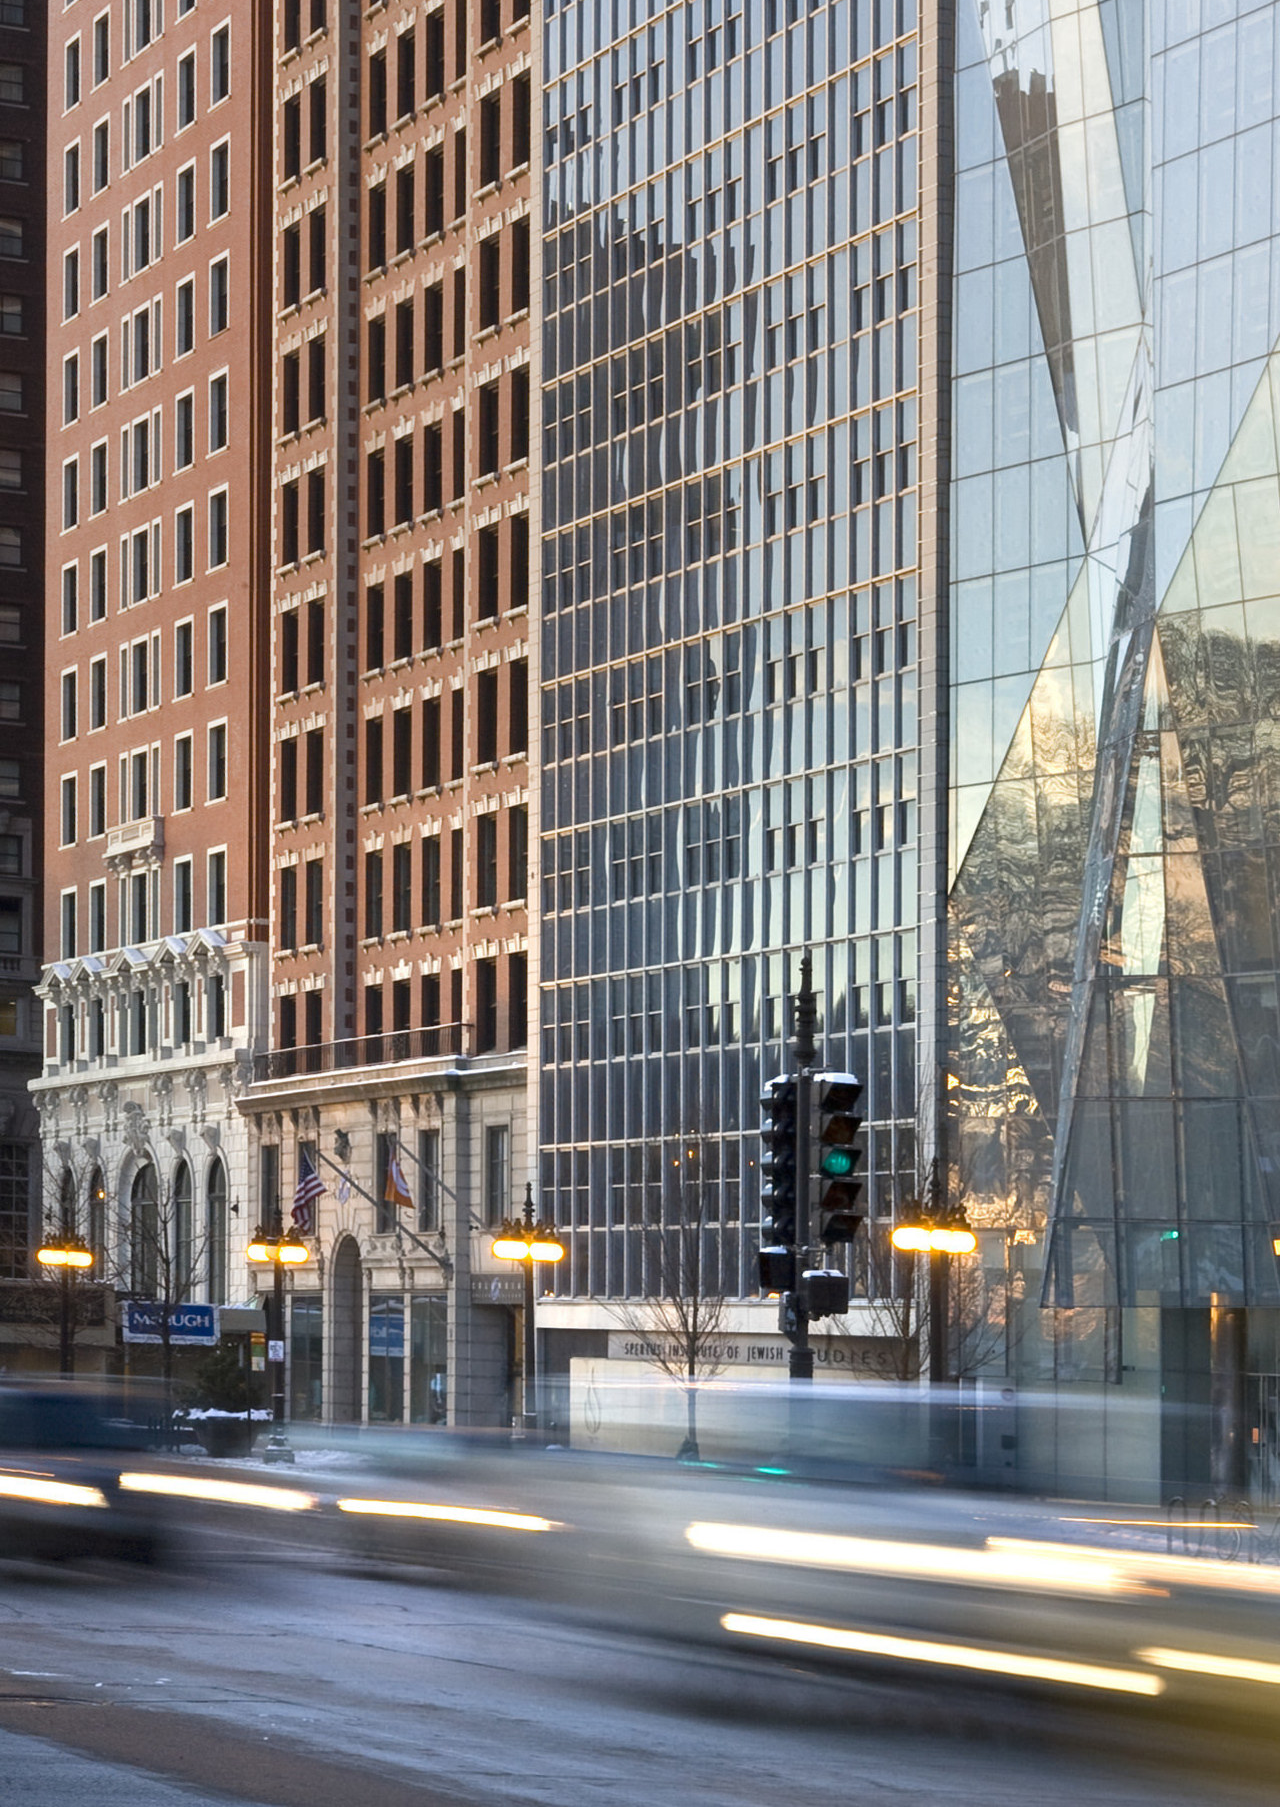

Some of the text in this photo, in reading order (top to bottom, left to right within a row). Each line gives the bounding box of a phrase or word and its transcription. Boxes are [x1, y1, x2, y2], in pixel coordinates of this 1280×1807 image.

[727, 1345, 740, 1360] OF
[747, 1346, 783, 1362] JEWISH
[816, 1348, 888, 1365] UDIES
